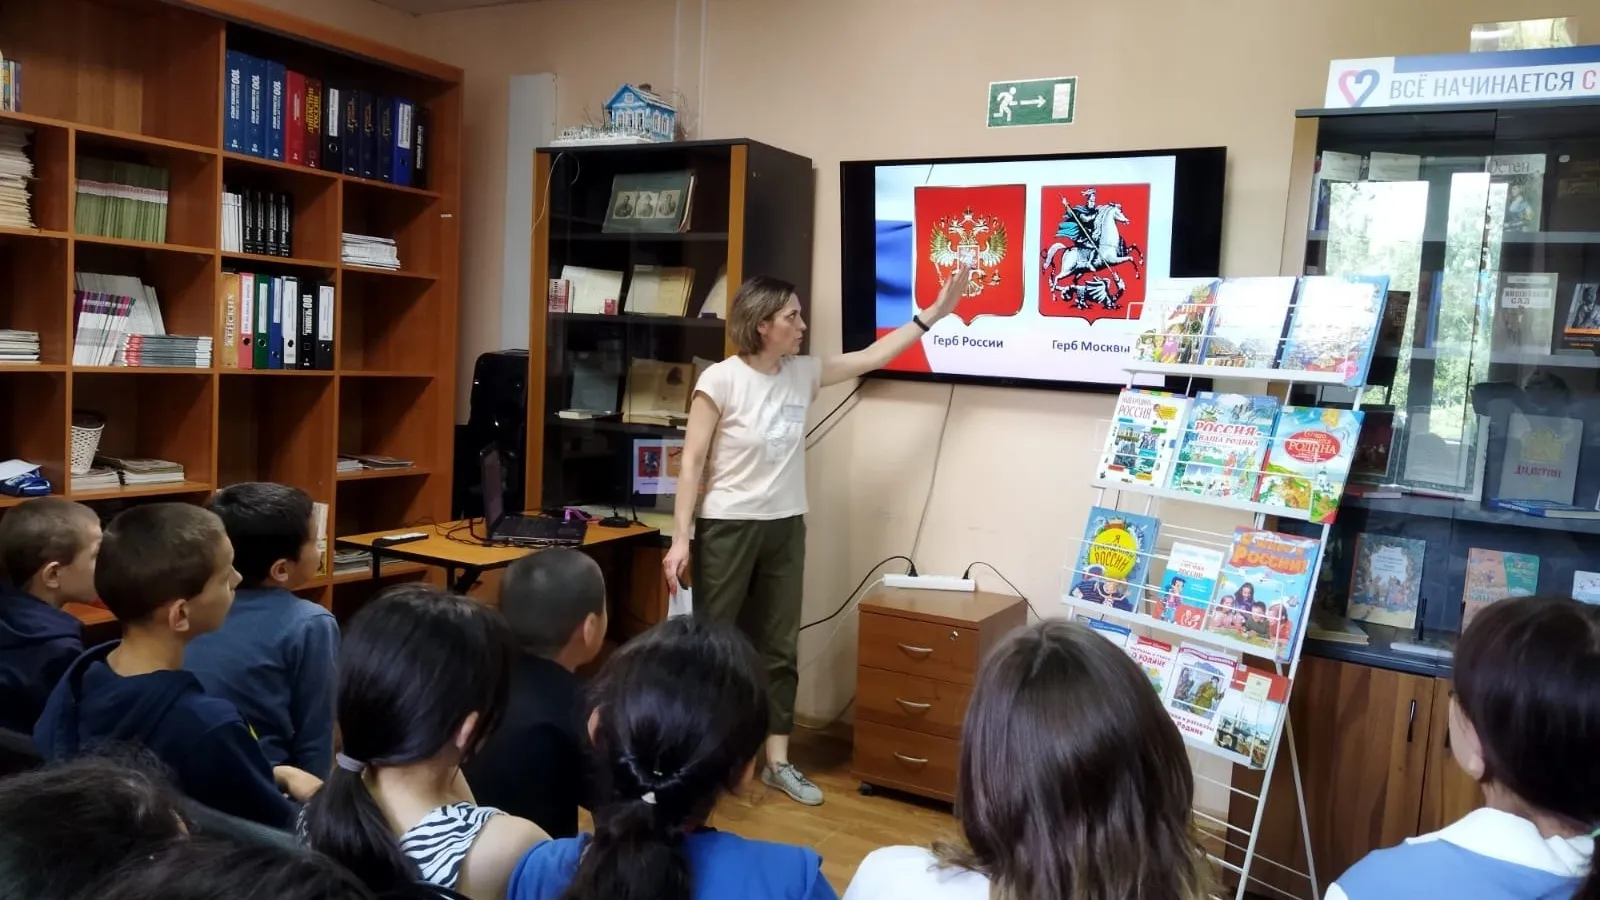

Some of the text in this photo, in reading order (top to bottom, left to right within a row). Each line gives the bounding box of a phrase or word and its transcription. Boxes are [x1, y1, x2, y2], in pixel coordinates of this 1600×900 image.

[1389, 69, 1596, 100] ВСЁ НАЧИНАЕТСЯ С
[302, 294, 313, 308] 100
[933, 334, 1004, 349] Герб России
[1052, 339, 1131, 354] Герб Москвы
[1094, 551, 1130, 573] РОССИИ
